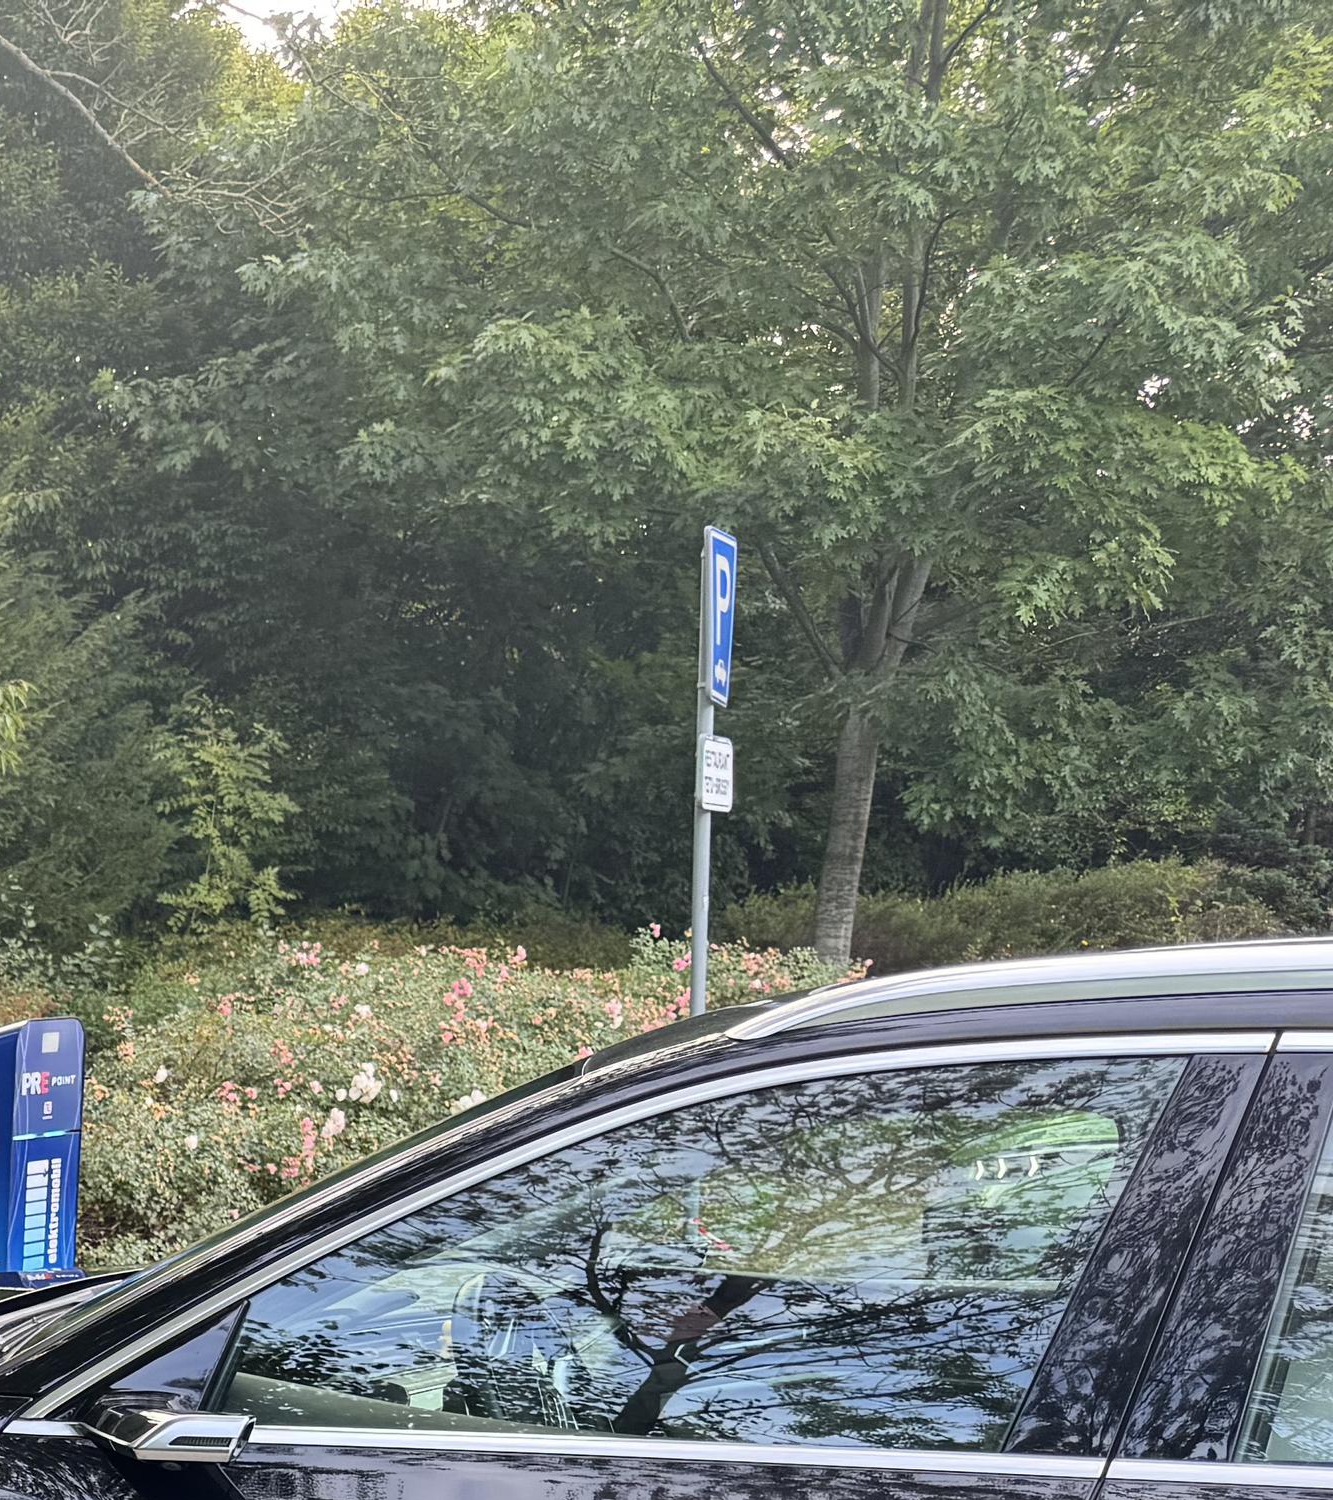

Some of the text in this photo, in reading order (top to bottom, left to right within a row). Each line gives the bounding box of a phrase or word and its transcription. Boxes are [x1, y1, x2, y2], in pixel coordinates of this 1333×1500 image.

[715, 553, 731, 646] P
[21, 1071, 76, 1096] PRE POINT
